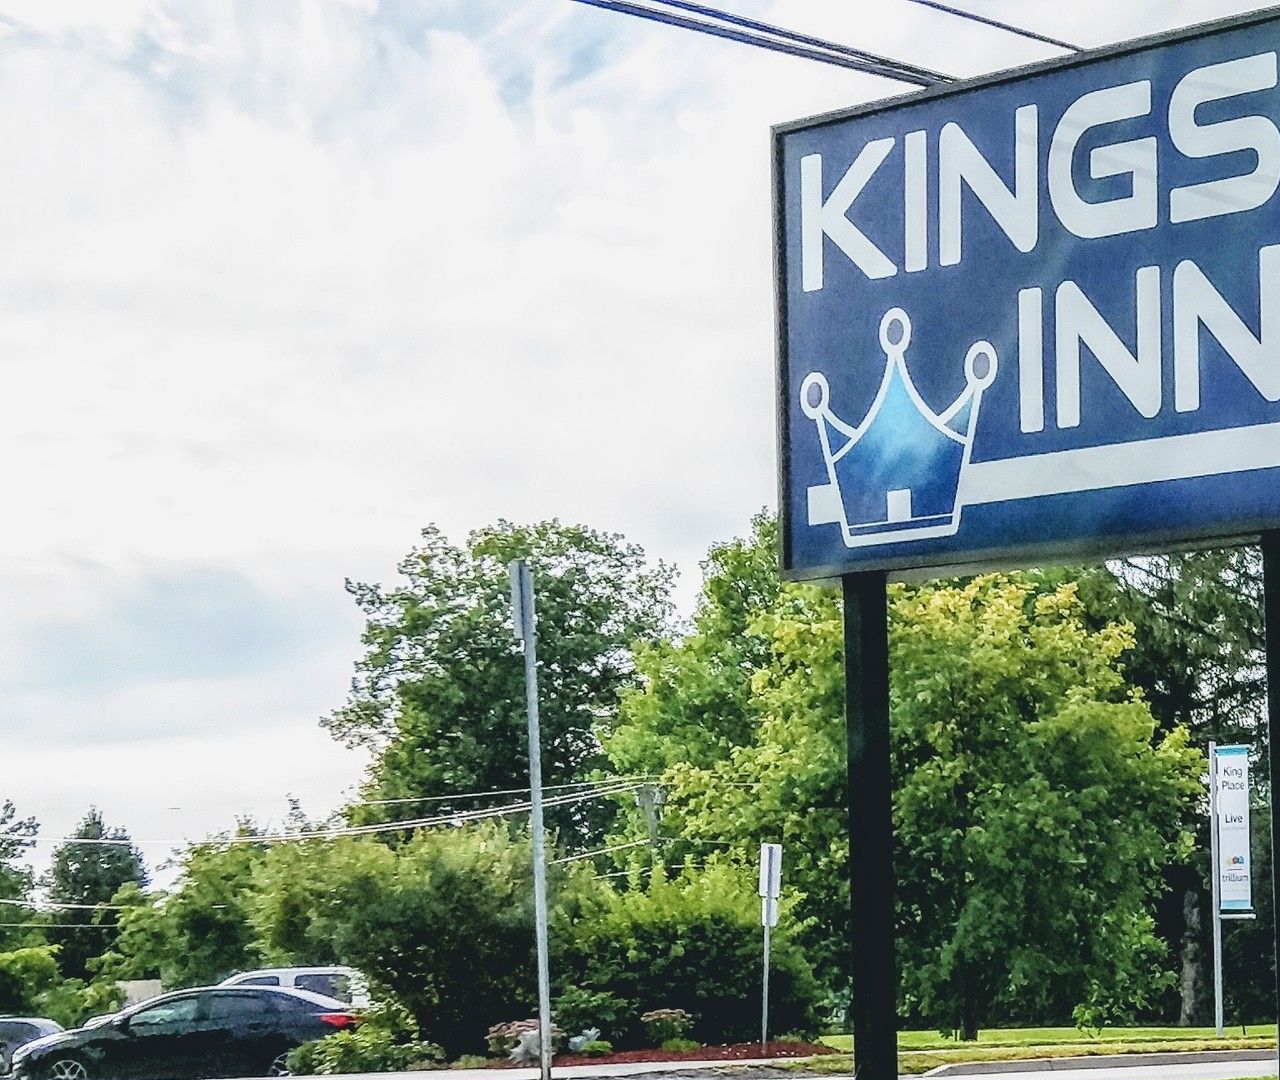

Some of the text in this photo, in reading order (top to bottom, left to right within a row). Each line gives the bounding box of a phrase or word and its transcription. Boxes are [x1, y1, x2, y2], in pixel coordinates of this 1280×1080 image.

[1223, 766, 1243, 778] King
[1221, 780, 1245, 790] Place
[1225, 813, 1243, 823] Live
